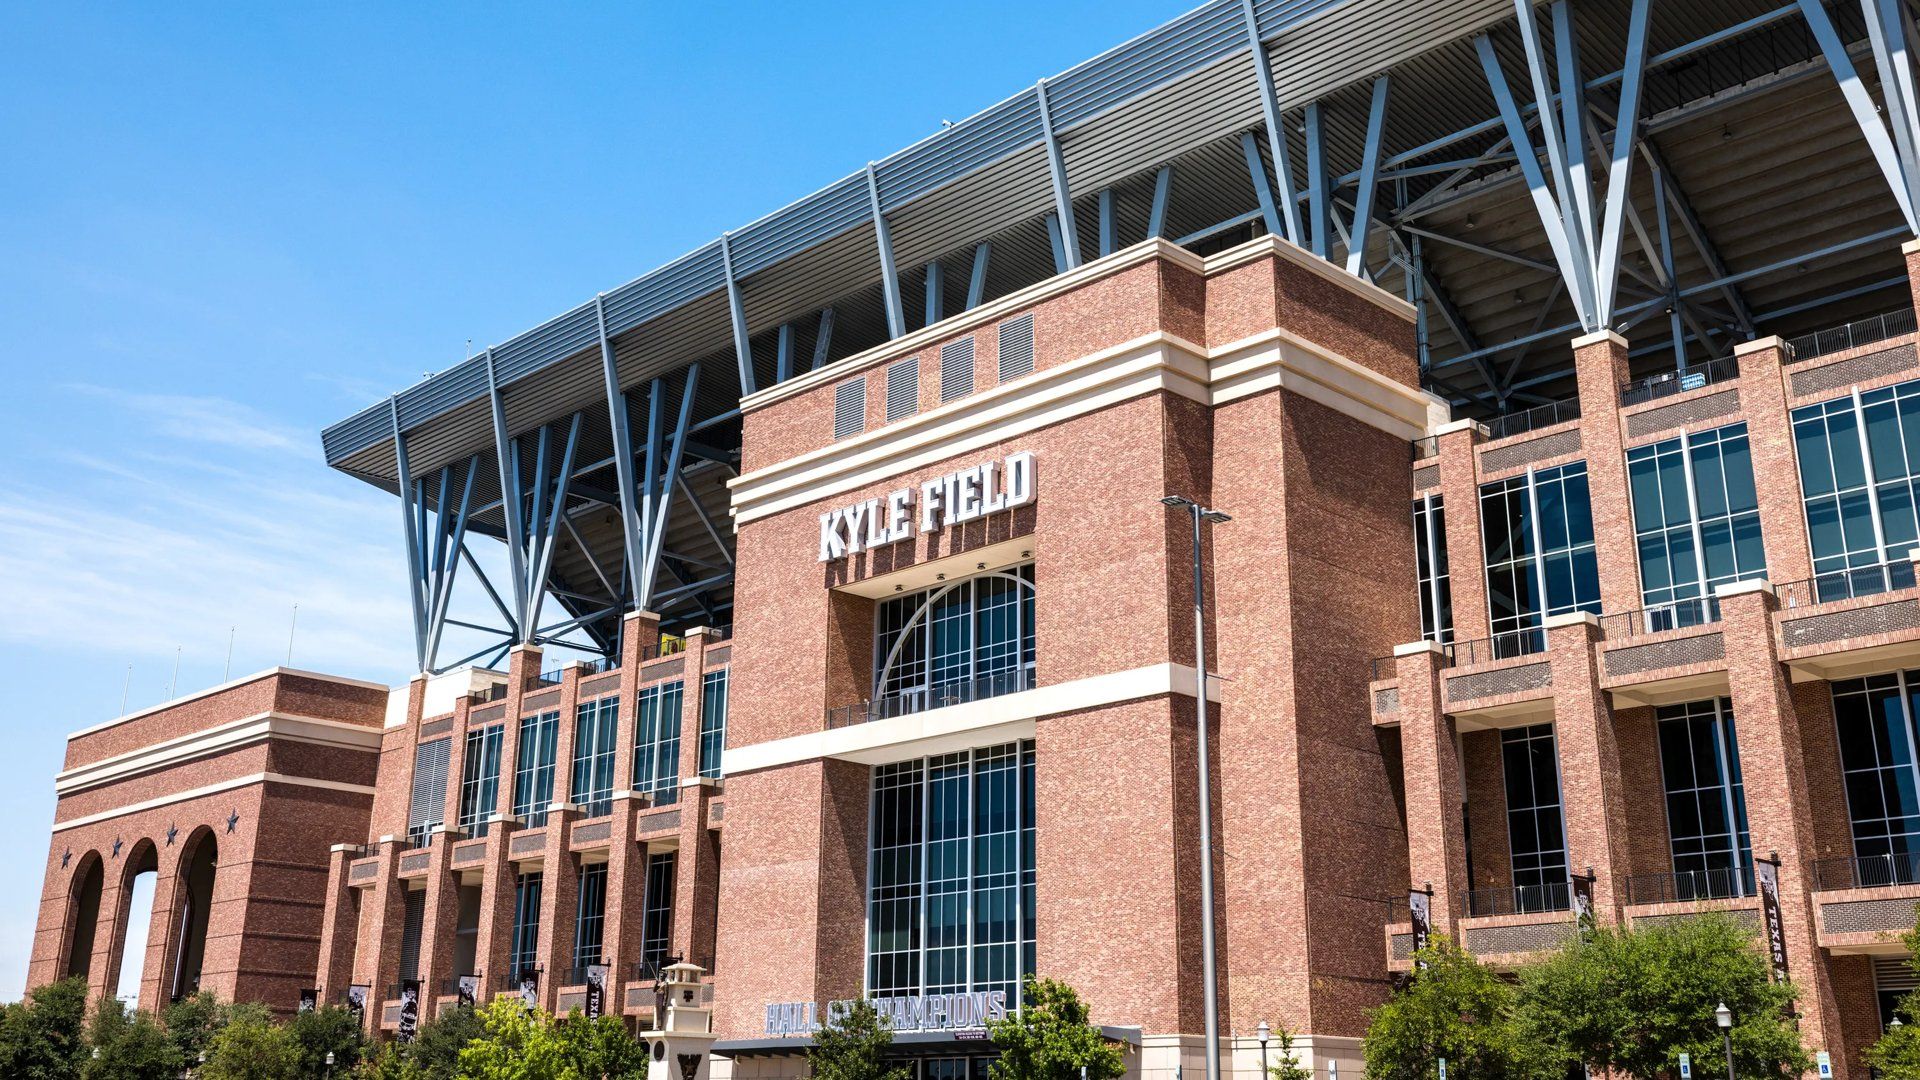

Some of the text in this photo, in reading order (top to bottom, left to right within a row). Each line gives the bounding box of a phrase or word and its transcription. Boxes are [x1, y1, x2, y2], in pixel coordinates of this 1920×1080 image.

[818, 451, 1037, 562] KYLE FIELD
[1768, 906, 1783, 963] TEXAS
[590, 991, 600, 1025] TEXAS
[765, 1002, 818, 1034] HALL
[865, 991, 1006, 1031] HAMPIONS
